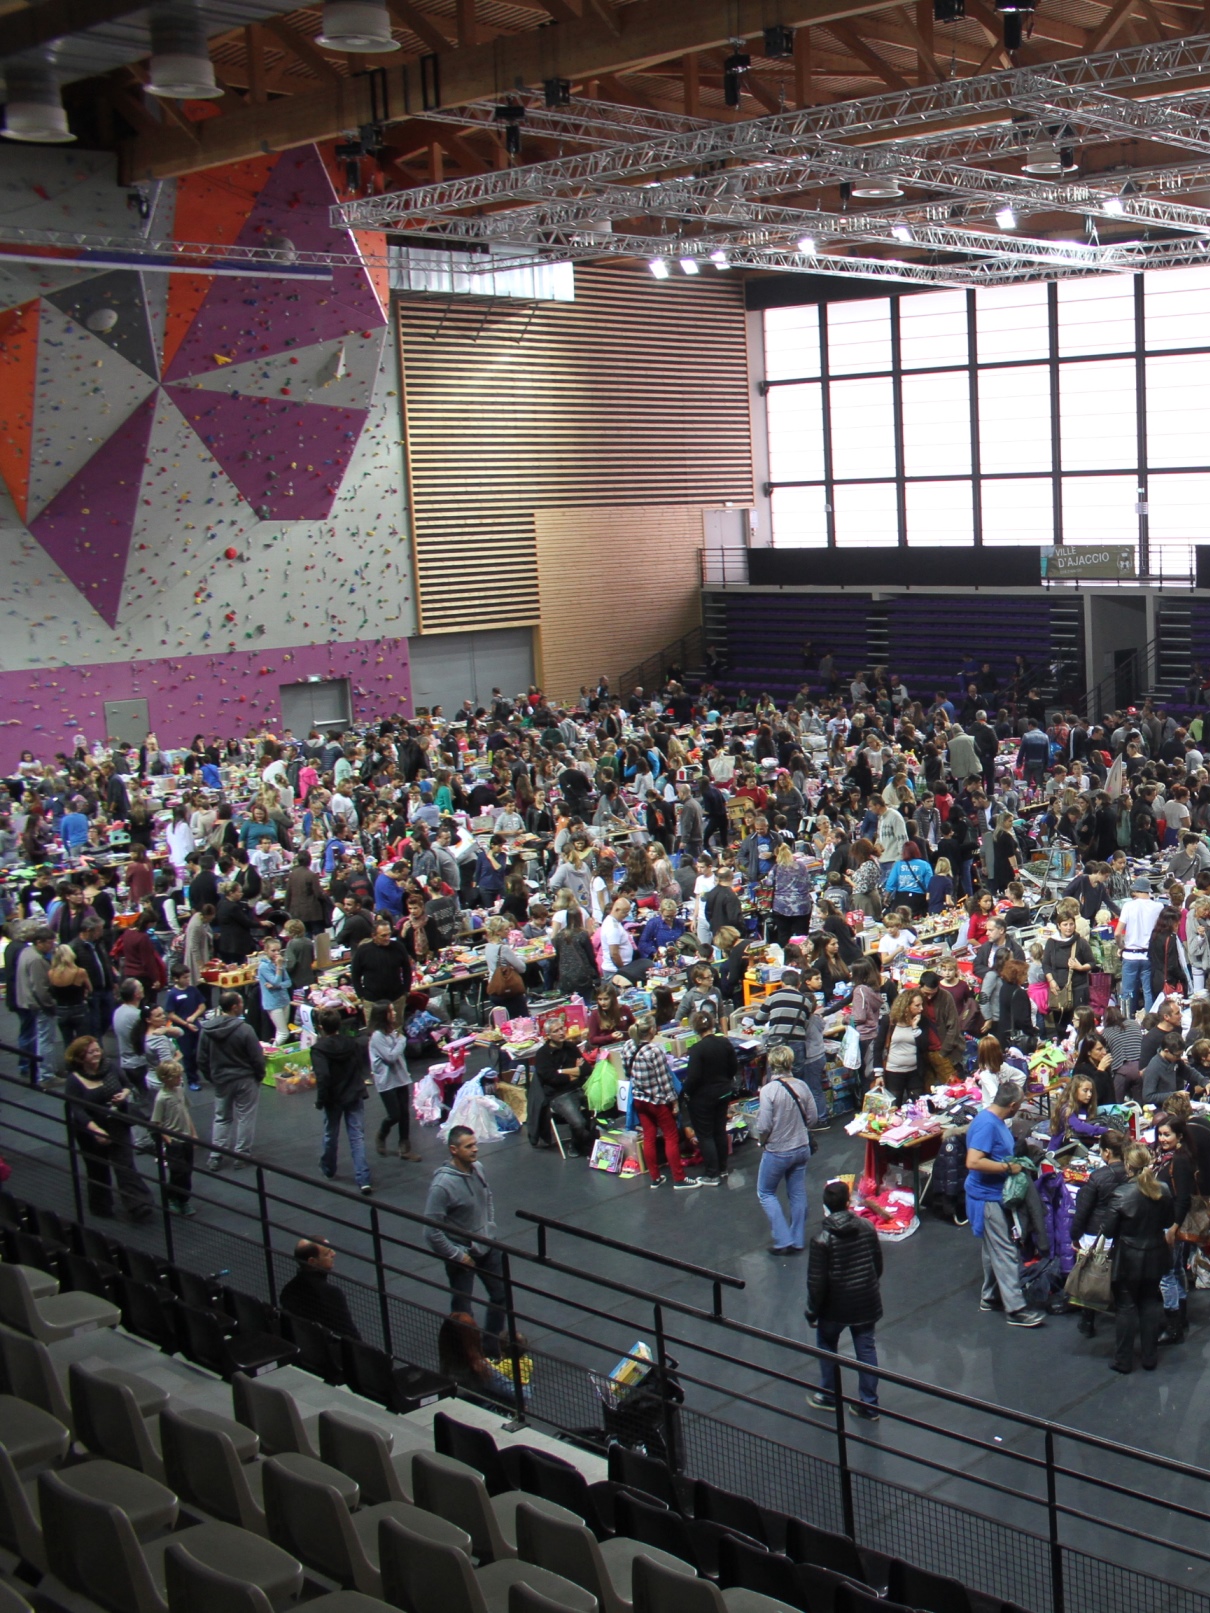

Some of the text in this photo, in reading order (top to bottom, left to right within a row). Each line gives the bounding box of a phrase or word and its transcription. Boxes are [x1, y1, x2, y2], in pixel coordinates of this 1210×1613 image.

[1055, 546, 1077, 557] VILLE
[1057, 552, 1110, 568] D'AJACCIO
[619, 1086, 627, 1101] C
